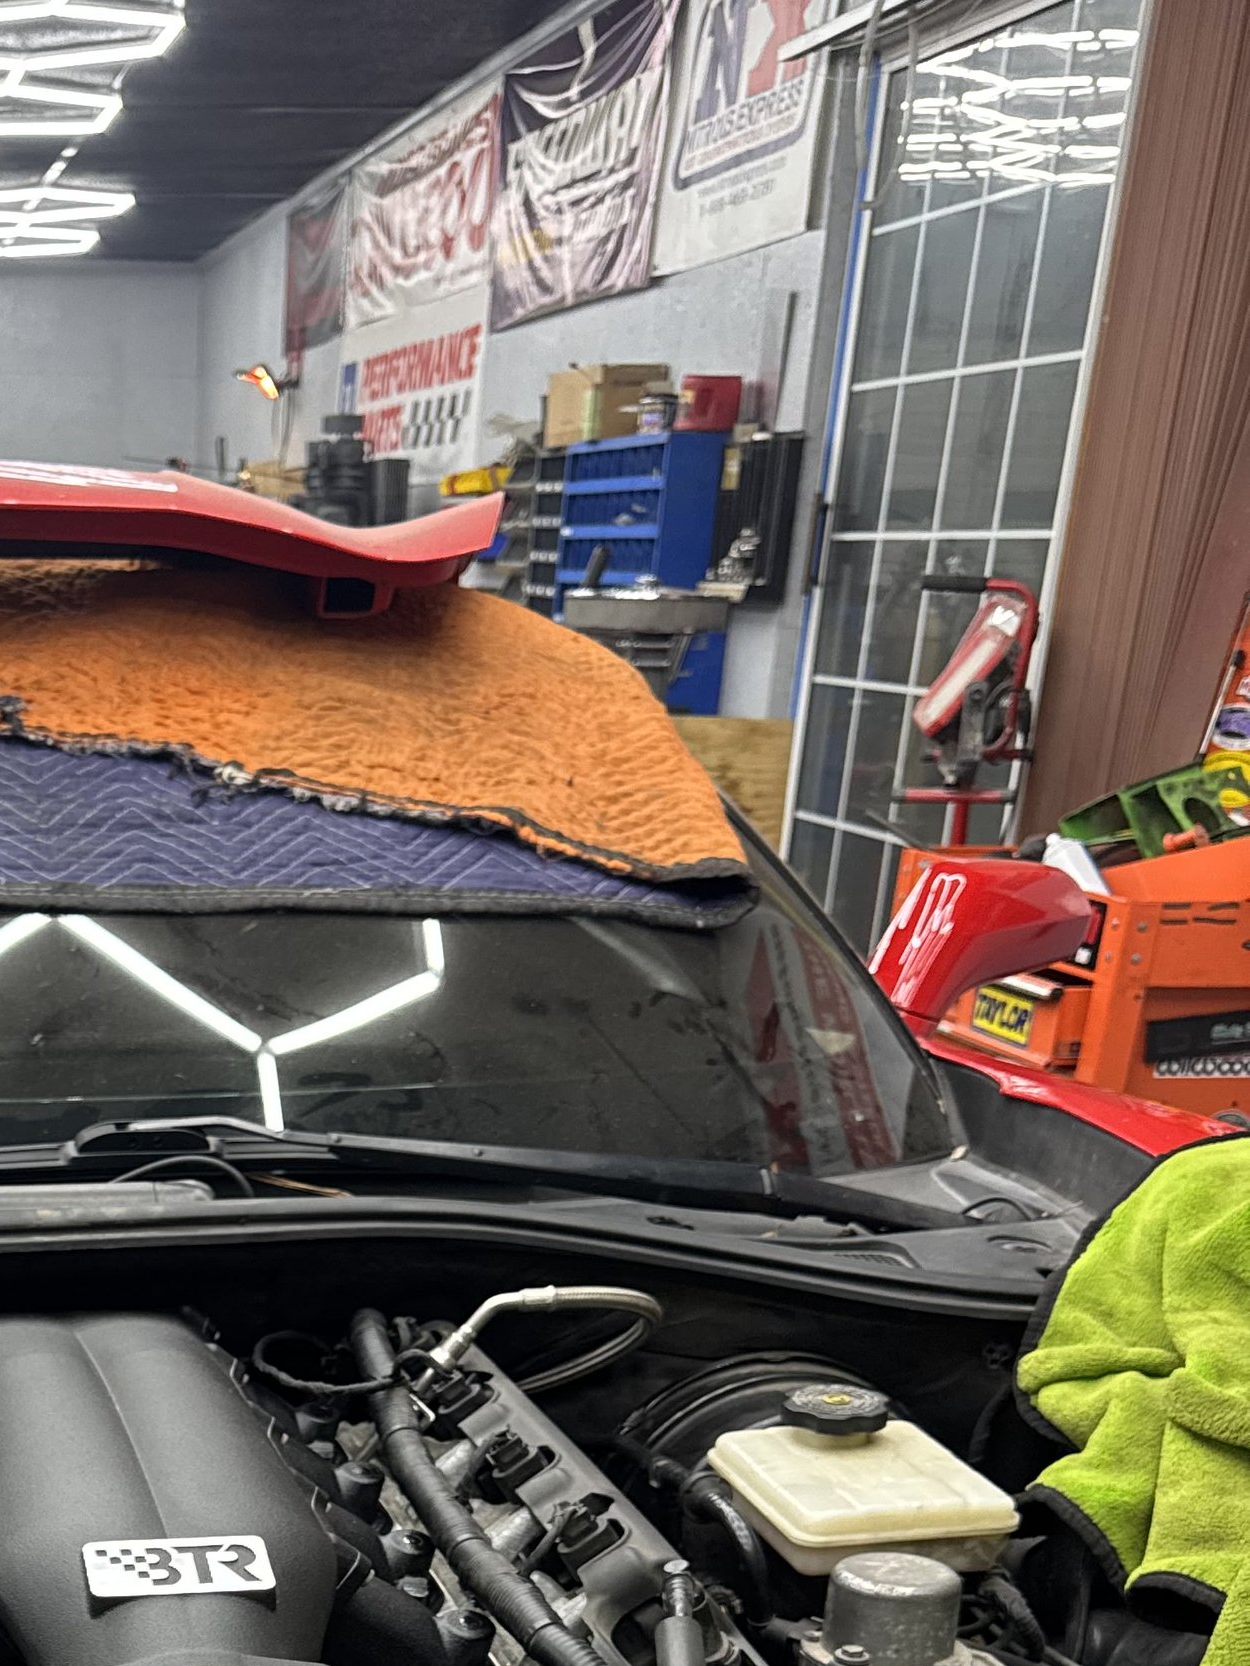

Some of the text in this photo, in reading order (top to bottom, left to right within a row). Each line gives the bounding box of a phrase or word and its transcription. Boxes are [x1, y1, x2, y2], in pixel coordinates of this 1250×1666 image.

[360, 322, 482, 402] PERFORMANCE
[974, 993, 1030, 1034] TAYLOR
[144, 1544, 263, 1586] BTR
